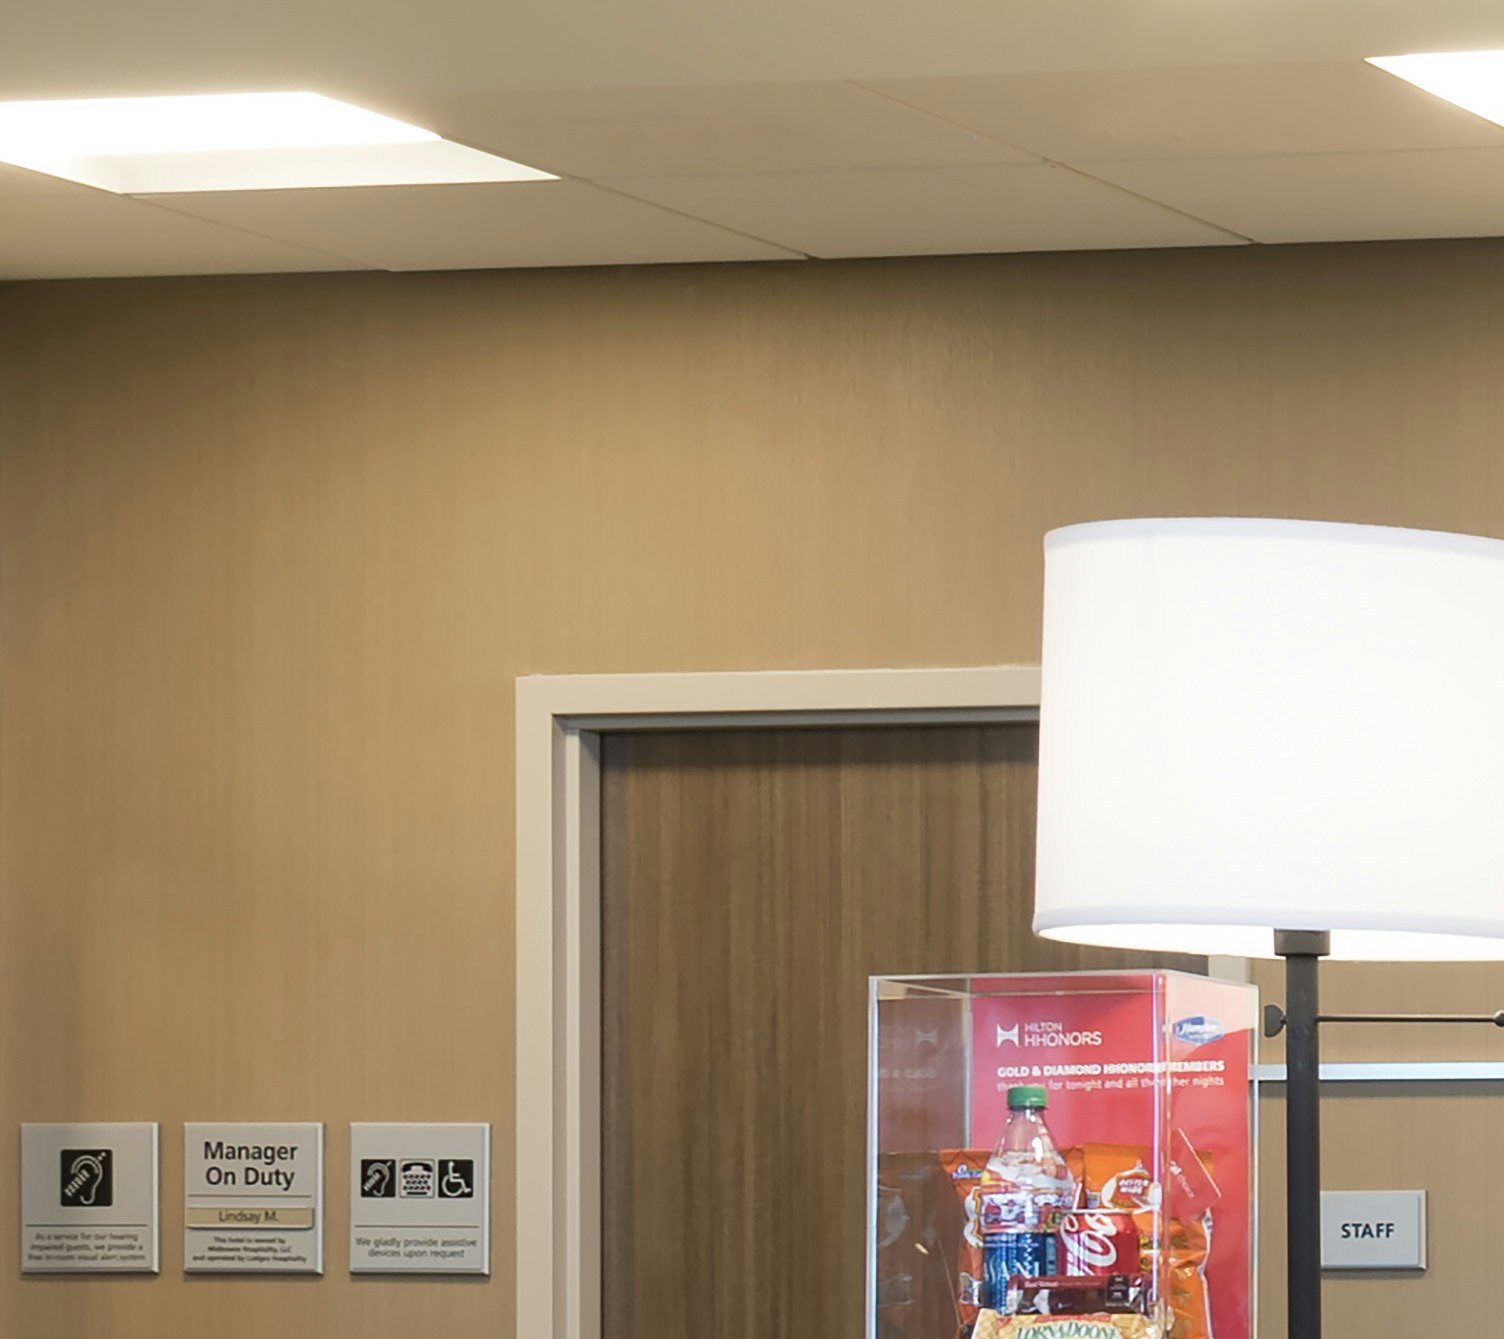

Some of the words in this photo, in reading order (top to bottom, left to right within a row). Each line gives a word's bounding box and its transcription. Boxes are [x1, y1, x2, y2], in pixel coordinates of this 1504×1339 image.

[1024, 1022, 1062, 1033] HILTON
[1024, 1031, 1102, 1048] HHONORS
[997, 1066, 1029, 1078] GOLD
[1031, 1065, 1041, 1077] &
[1043, 1064, 1102, 1076] DIAMOND
[203, 1140, 299, 1166] Manager
[205, 1166, 236, 1185] On
[244, 1167, 296, 1191] Duty
[1340, 1222, 1395, 1239] STAFF
